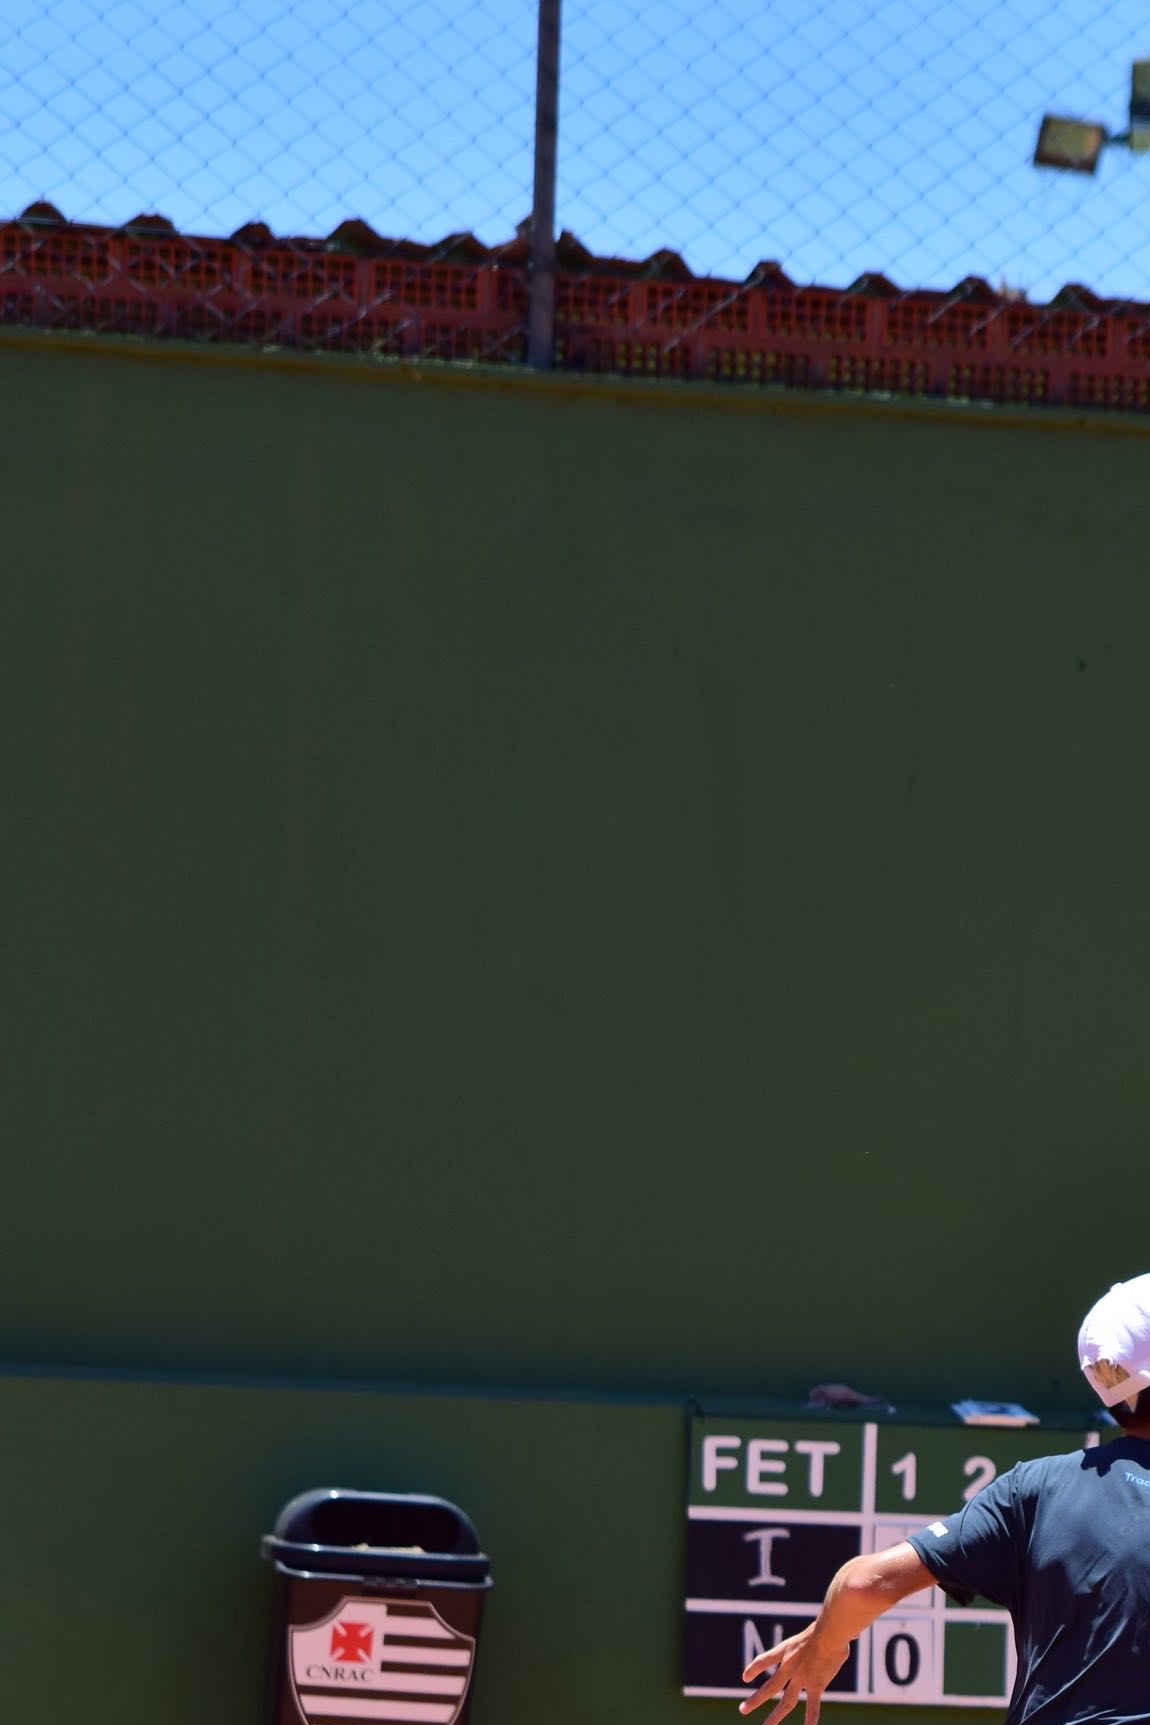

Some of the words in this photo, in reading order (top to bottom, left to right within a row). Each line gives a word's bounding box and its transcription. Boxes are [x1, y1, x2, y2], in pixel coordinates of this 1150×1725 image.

[703, 1435, 841, 1497] FET
[892, 1452, 916, 1500] 1
[963, 1455, 997, 1501] 2
[743, 1528, 791, 1587] I
[306, 1664, 374, 1681] CNRAC
[884, 1633, 920, 1686] 0
